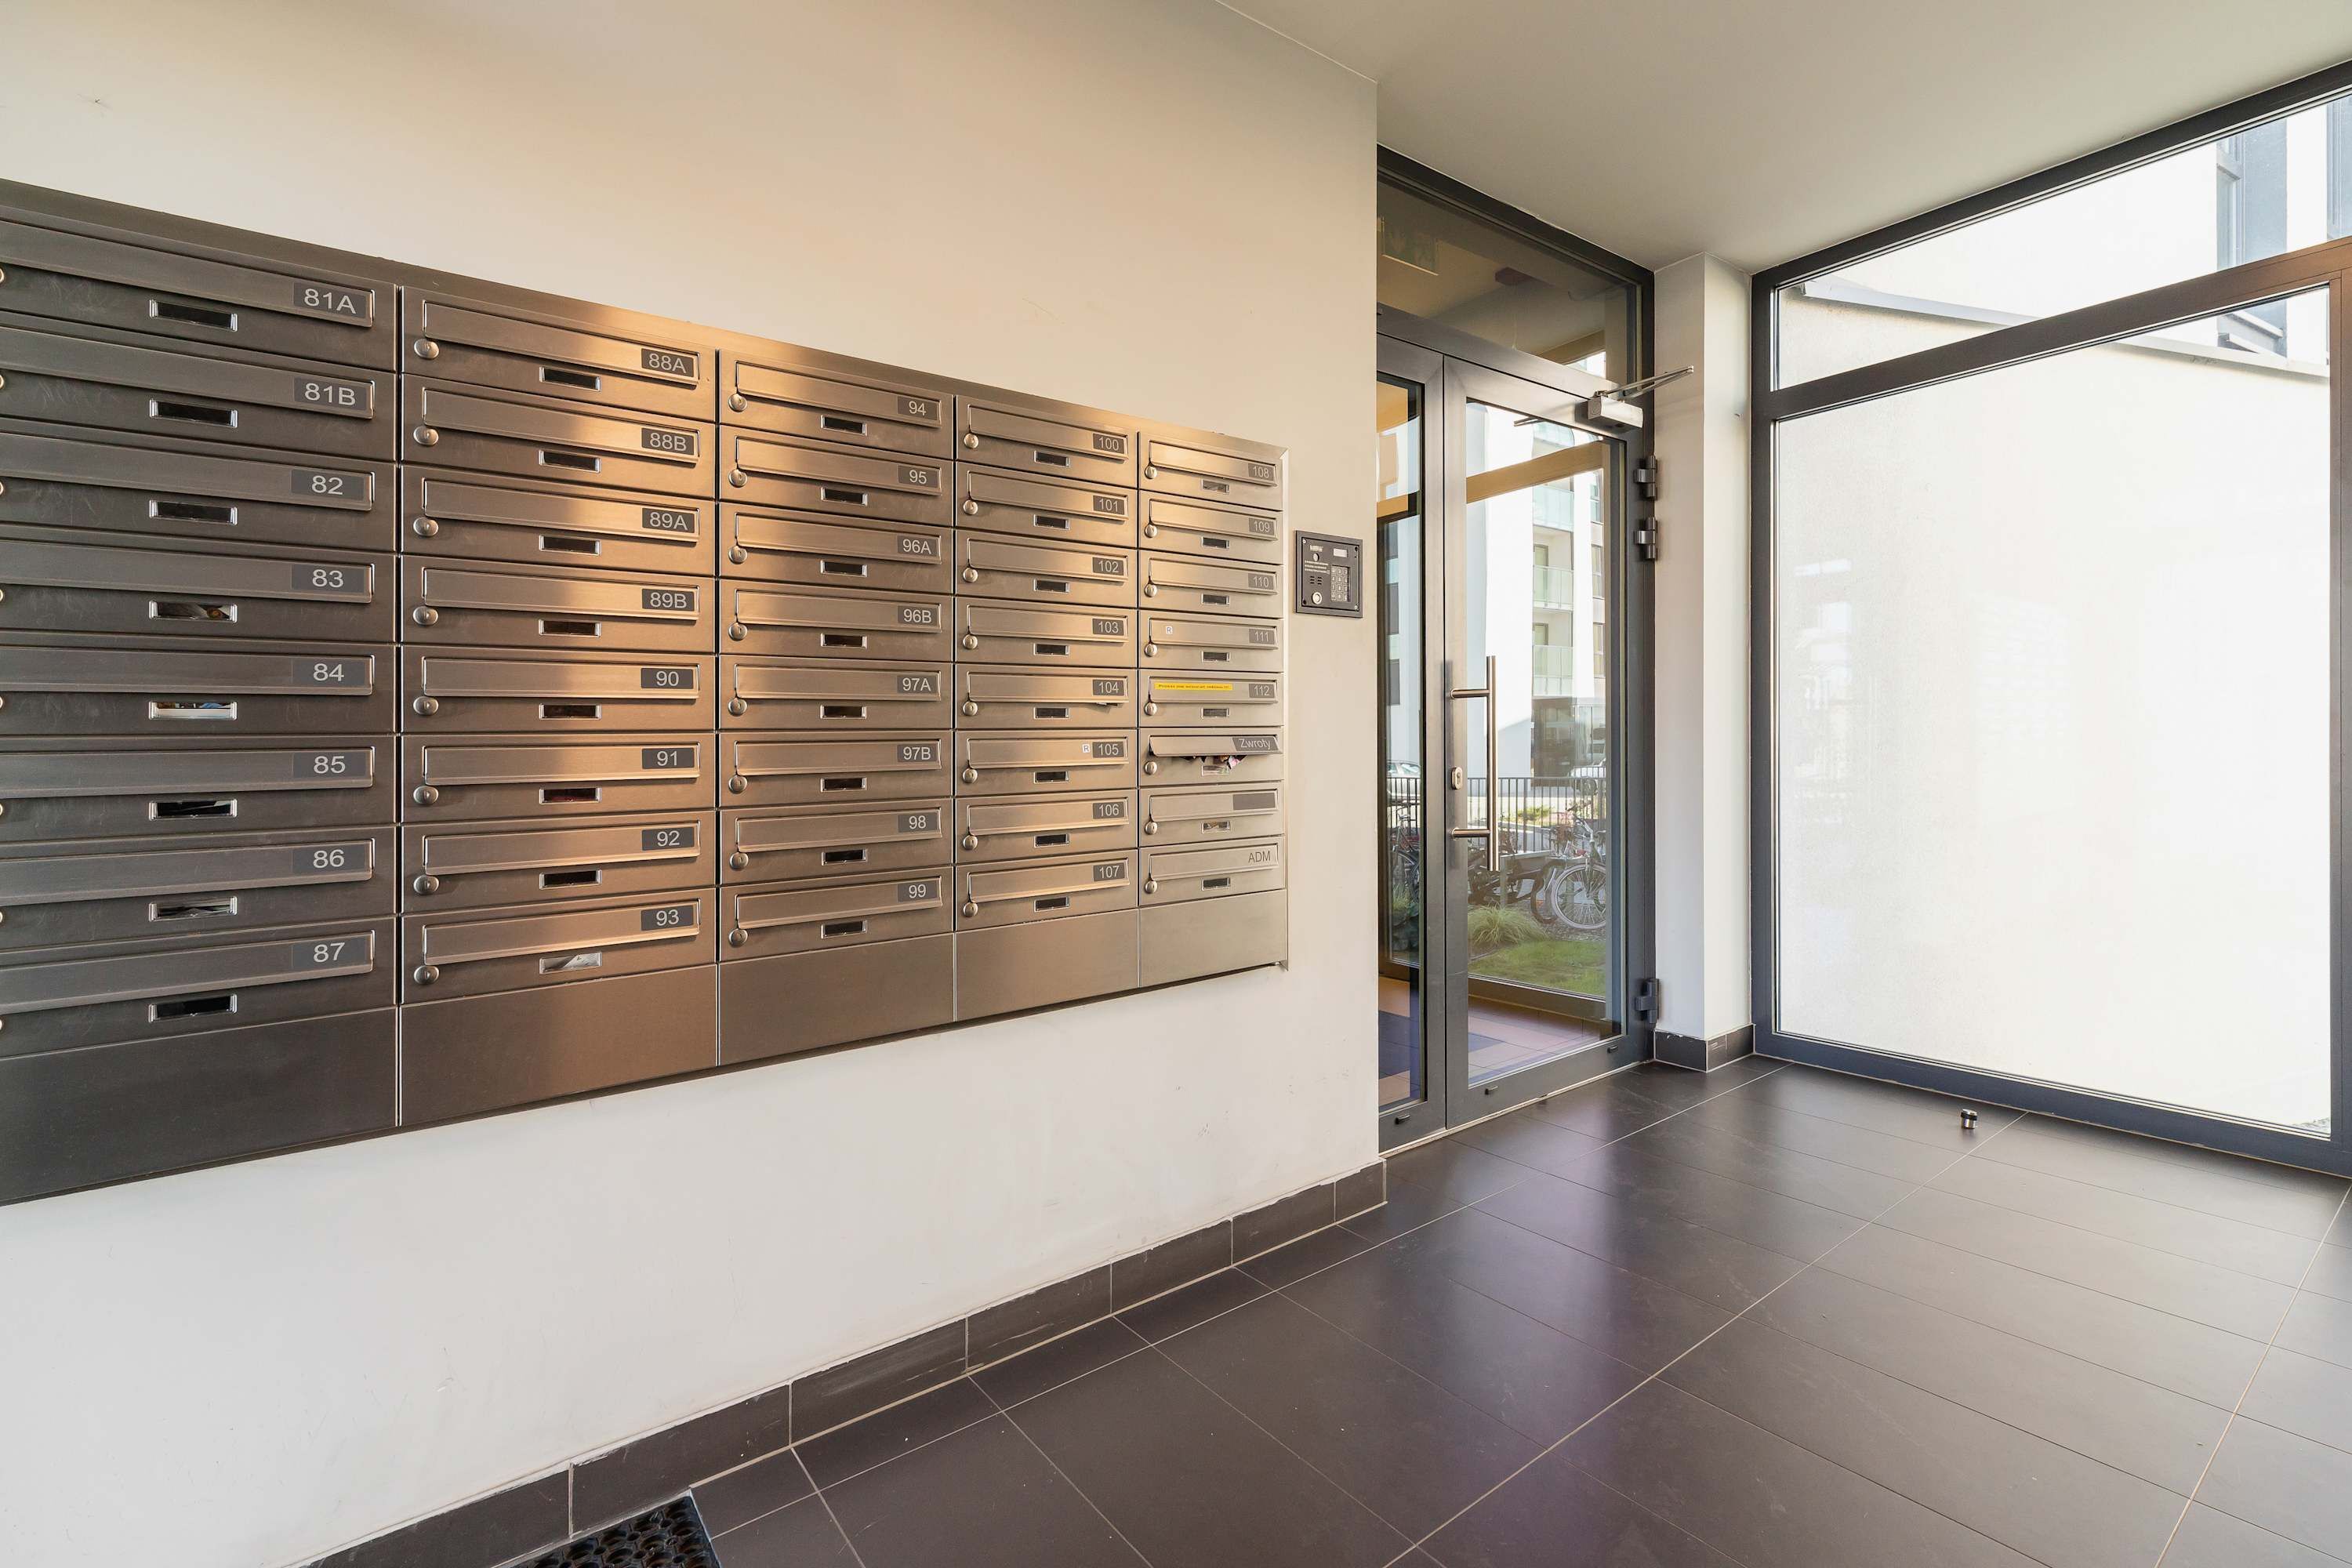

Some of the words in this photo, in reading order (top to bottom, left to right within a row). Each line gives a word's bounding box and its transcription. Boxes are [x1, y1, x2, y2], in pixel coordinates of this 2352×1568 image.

[304, 289, 356, 314] 81A
[648, 354, 686, 373] 88A
[305, 381, 357, 406] 81B
[909, 401, 926, 416] 94
[649, 433, 687, 452] 88B
[1099, 437, 1119, 451] 100
[909, 470, 927, 485] 95
[1253, 466, 1269, 478] 108
[312, 476, 343, 495] 82
[1099, 499, 1118, 512] 101
[649, 512, 688, 531] 89A
[1254, 521, 1270, 533] 109
[902, 539, 931, 555] 96A
[1098, 560, 1119, 573] 102
[312, 569, 343, 588] 83
[1254, 575, 1269, 588] 110
[650, 592, 687, 608] 89B
[903, 609, 931, 624] 96B
[1098, 621, 1119, 633] 103
[1254, 631, 1269, 641] 111
[313, 663, 344, 681] 84
[656, 671, 680, 687] 90
[902, 678, 931, 691] 97A
[1098, 681, 1119, 693] 104
[1254, 685, 1270, 696] 112
[1098, 744, 1119, 756] 105
[1240, 739, 1271, 750] Zwroty
[657, 750, 678, 767] 91
[903, 747, 931, 761] 97B
[314, 756, 345, 774] 85
[1098, 804, 1119, 816] 106
[909, 815, 926, 829] 98
[657, 831, 680, 848] 92
[313, 849, 344, 869] 86
[1248, 851, 1270, 863] ADM
[1099, 866, 1119, 879] 107
[909, 884, 926, 898] 99
[656, 909, 680, 926] 93
[314, 942, 345, 963] 87
